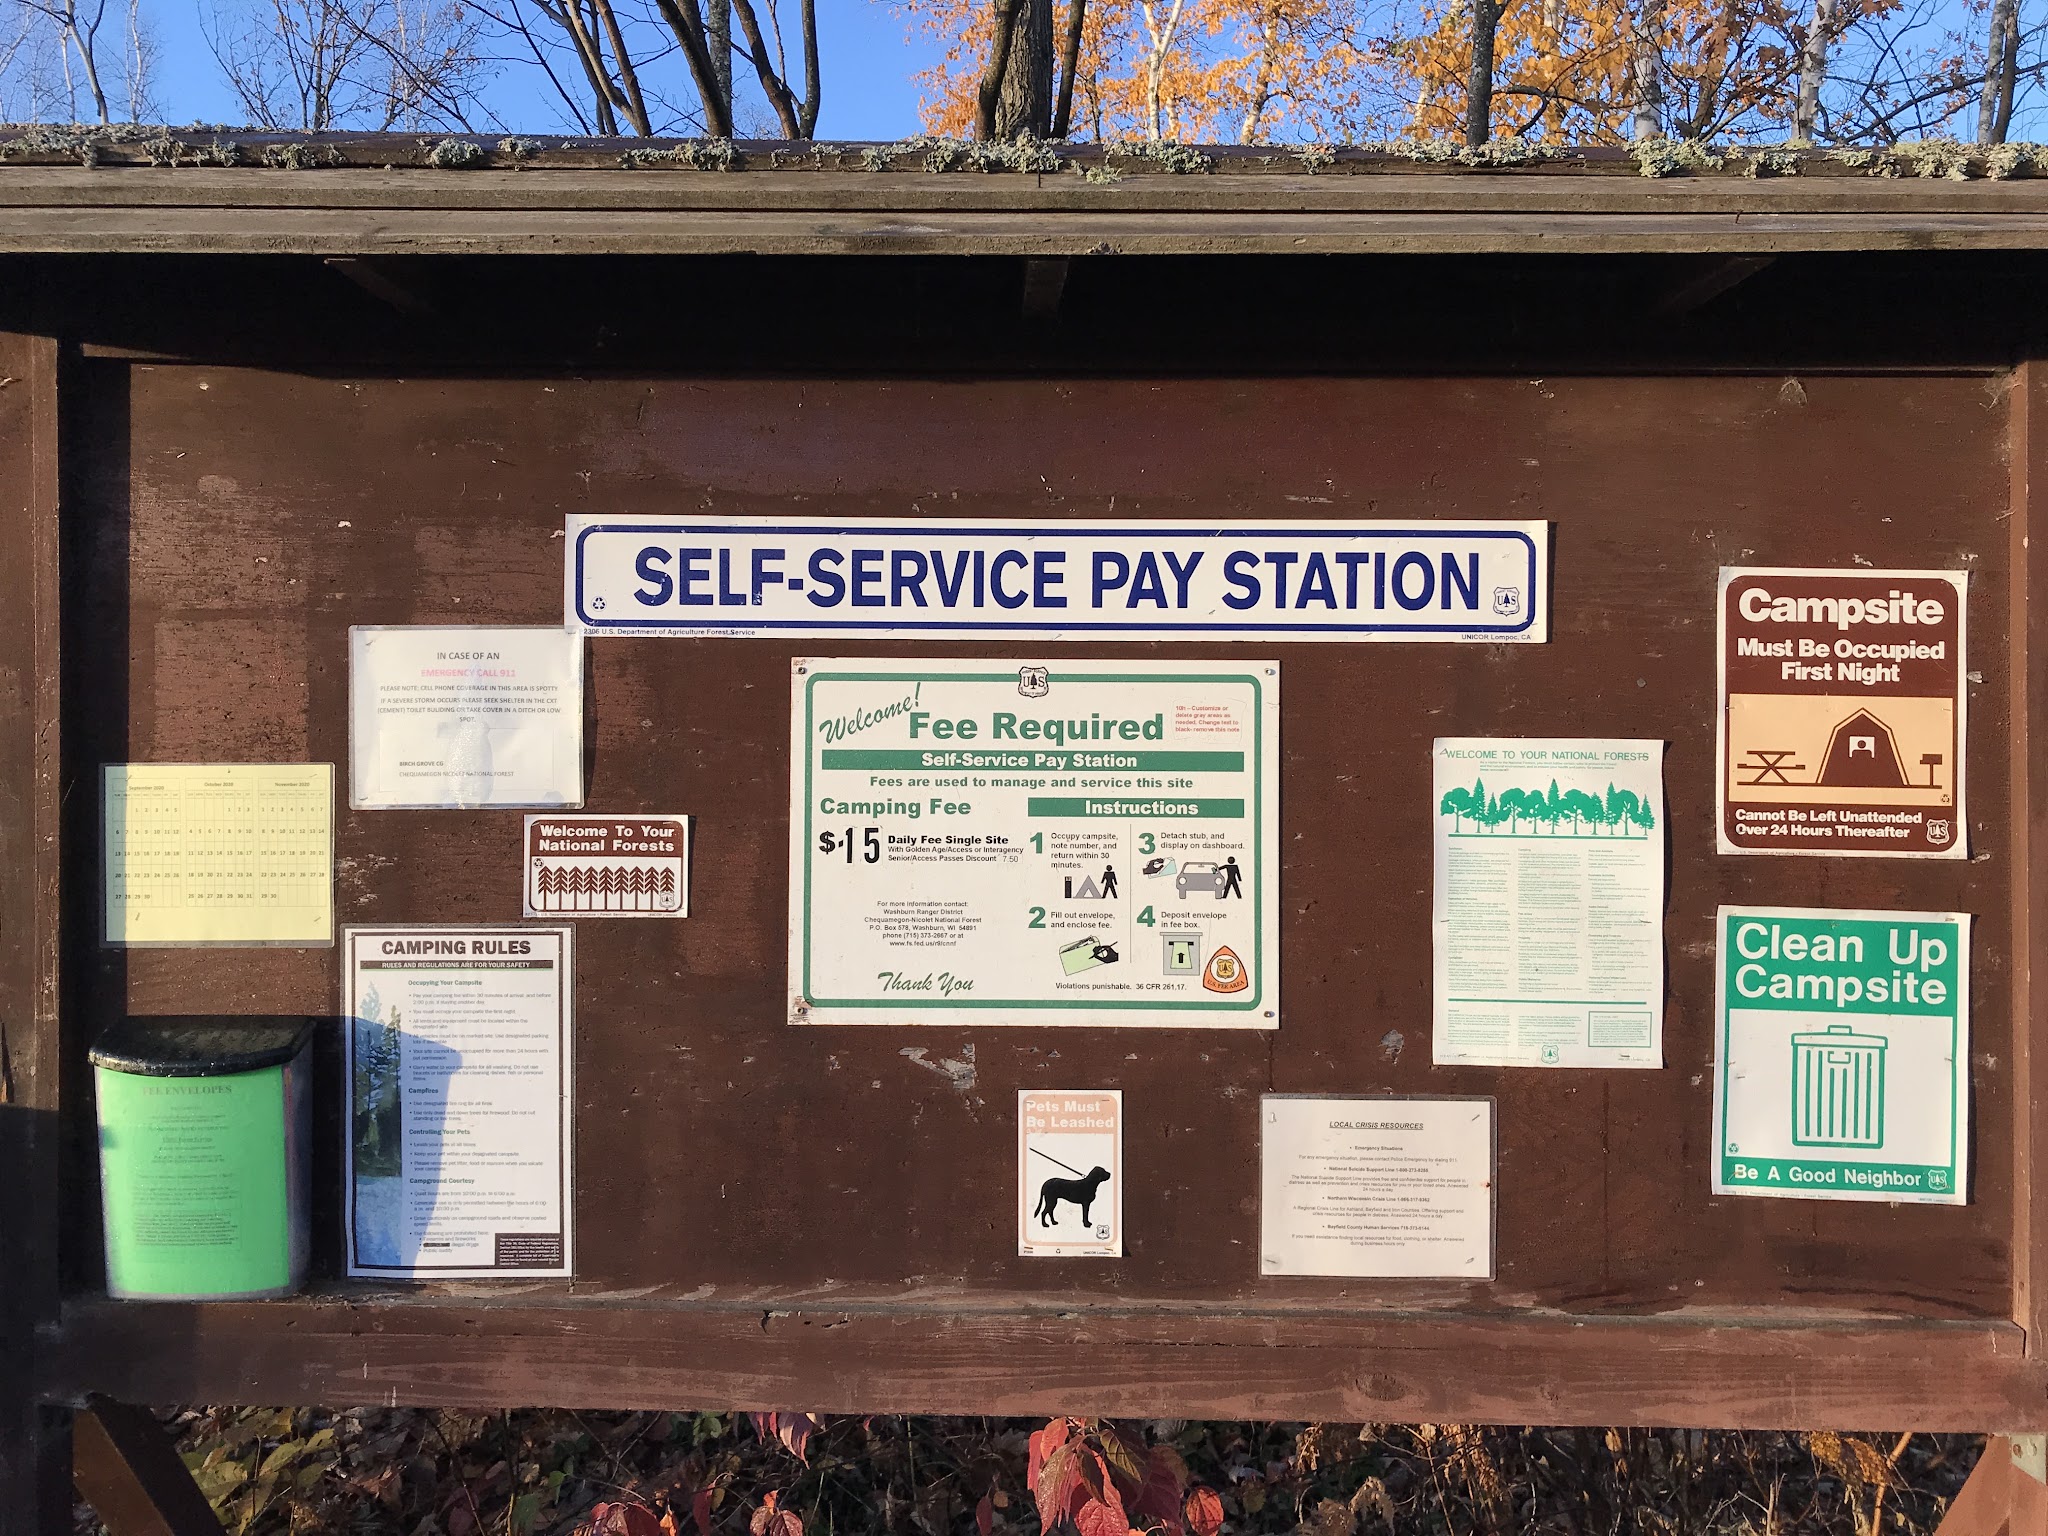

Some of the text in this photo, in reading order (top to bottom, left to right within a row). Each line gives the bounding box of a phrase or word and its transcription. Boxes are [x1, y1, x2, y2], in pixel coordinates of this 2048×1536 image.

[633, 546, 1479, 610] SELF-SERVICE PAY STATION
[1738, 588, 1944, 630] Campsite
[1738, 638, 1944, 662] Must Be Occupied
[476, 668, 498, 677] CALL
[1782, 661, 1899, 684] First Night
[819, 682, 920, 743] Welcome!
[910, 712, 1163, 746] Fee Required
[922, 752, 1136, 769] Self-Service Pay Station
[1447, 750, 1649, 761] WELCOME TO YOUR NATIONAL FORESTS
[870, 776, 902, 786] Fees
[935, 776, 967, 786] used
[973, 777, 986, 786] to
[991, 779, 1045, 789] manage
[1051, 777, 1075, 787] and
[1081, 777, 1131, 787] service
[1136, 777, 1162, 787] this
[1167, 778, 1192, 787] site
[820, 797, 970, 818] Camping Fee
[1086, 800, 1198, 814] Instructions
[1735, 809, 1921, 823] Cannot Be Left Unattended
[540, 825, 674, 836] Welcome To Your
[888, 835, 916, 846] Daily
[946, 836, 981, 846] Single
[1051, 832, 1079, 841] Occupy
[1736, 823, 1909, 837] Over 24 Hours Thereafter
[539, 840, 673, 851] National Forests
[1030, 832, 1042, 854] 1
[1138, 833, 1156, 854] 3
[1028, 906, 1046, 928] 2
[1137, 906, 1156, 927] 4
[382, 940, 530, 954] CAMPING RULES
[1736, 923, 1948, 972] Clean Up
[878, 972, 974, 997] Thank You
[1736, 964, 1947, 1007] Campsite
[1026, 1100, 1100, 1112] Pets Must
[1026, 1116, 1114, 1128] Be Leashed
[1735, 1164, 1920, 1188] Be A Good Neighbor
